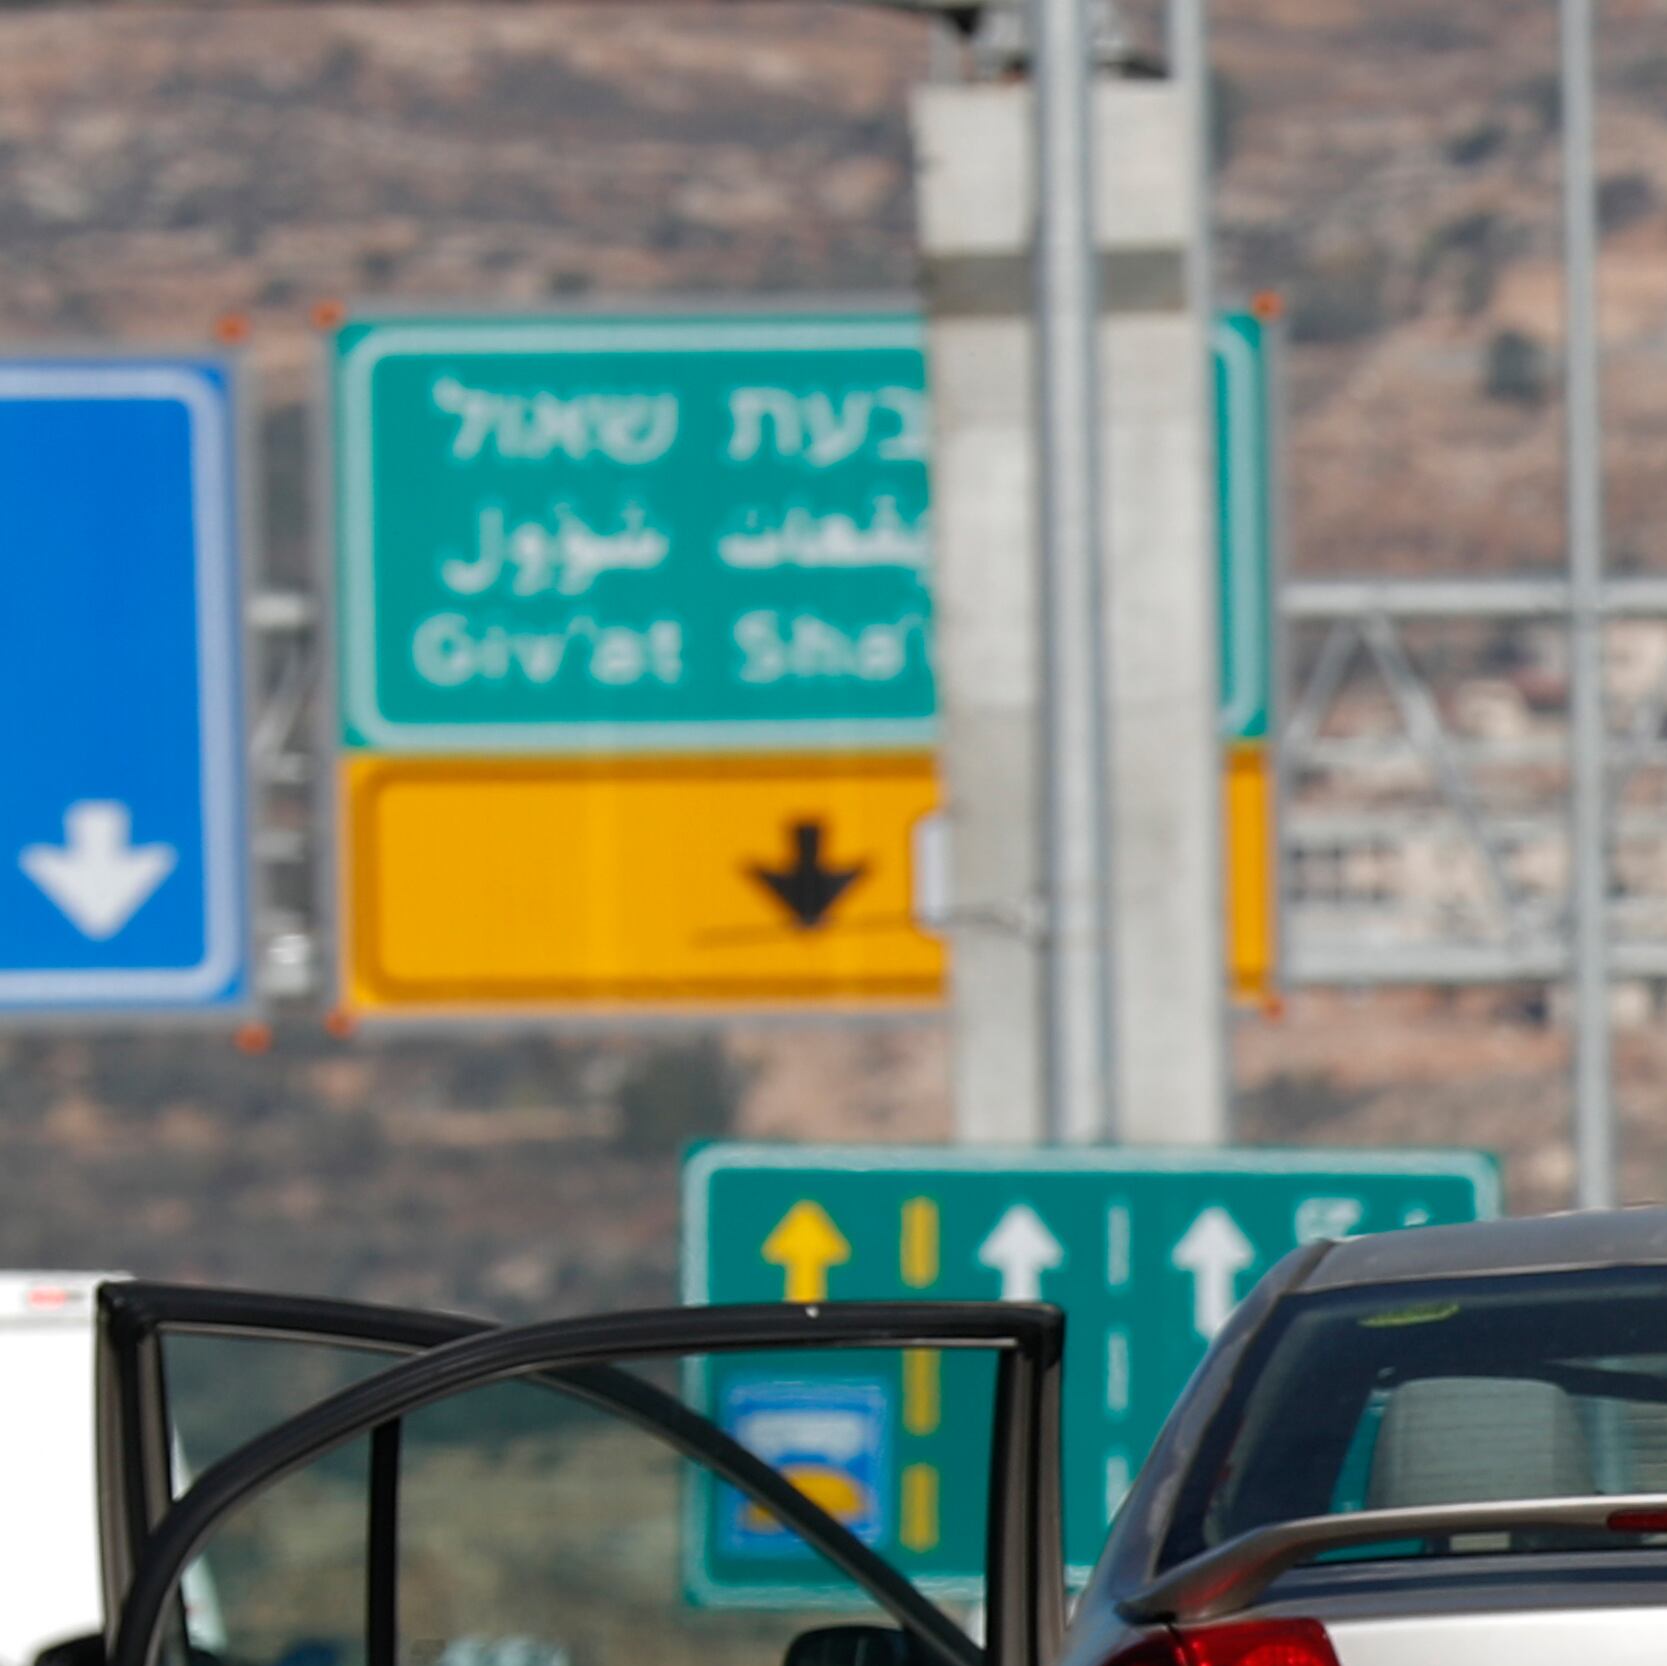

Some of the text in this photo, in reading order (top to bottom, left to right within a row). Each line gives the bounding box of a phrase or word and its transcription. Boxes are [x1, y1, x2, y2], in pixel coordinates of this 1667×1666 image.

[432, 375, 927, 466] בעת שאול
[412, 608, 926, 688] Giv'at Sha'
